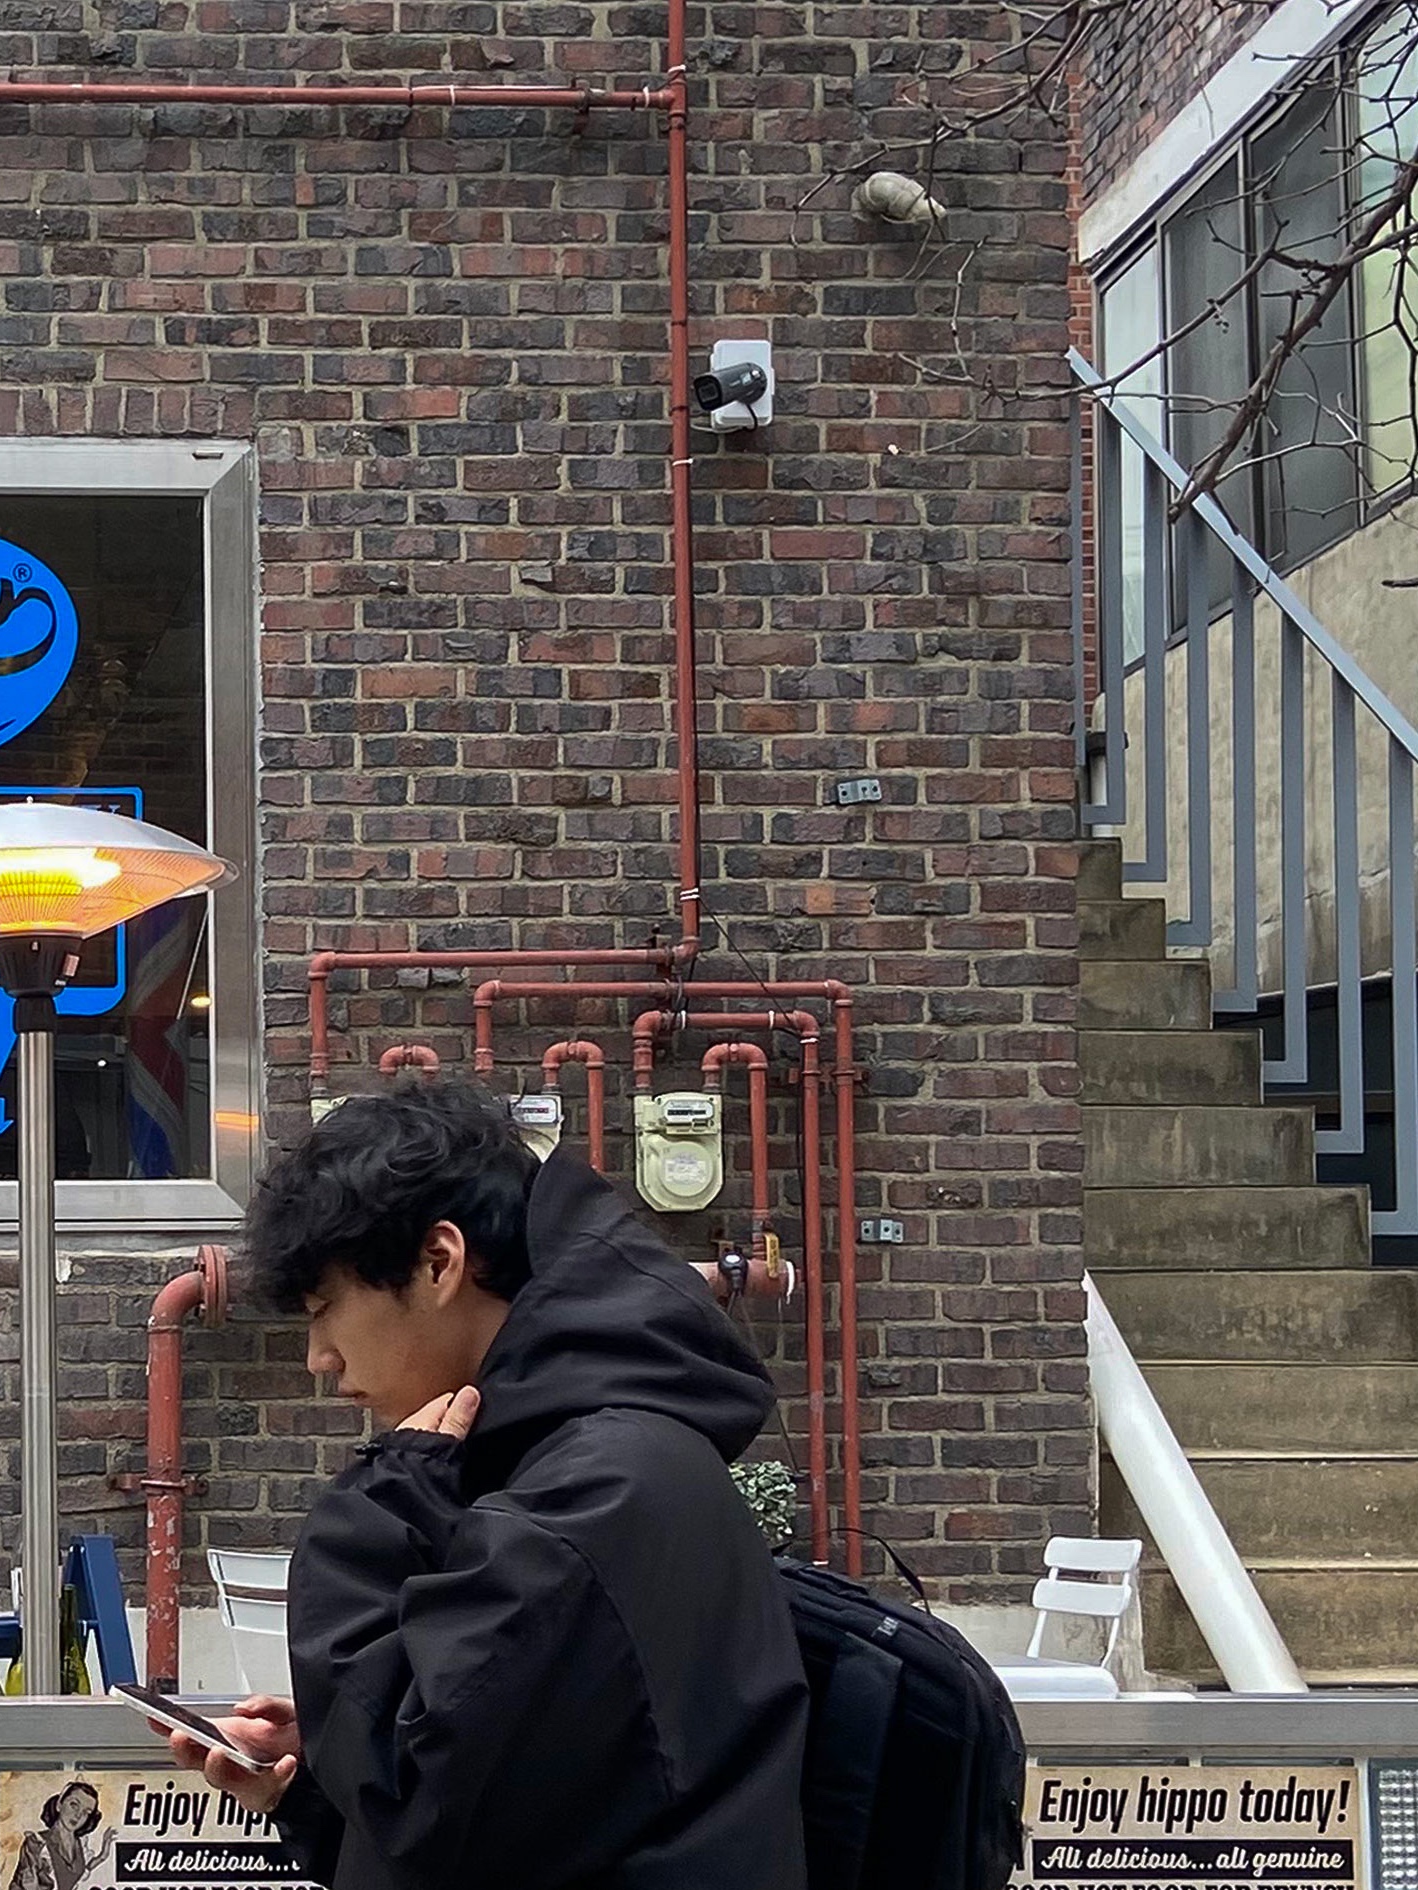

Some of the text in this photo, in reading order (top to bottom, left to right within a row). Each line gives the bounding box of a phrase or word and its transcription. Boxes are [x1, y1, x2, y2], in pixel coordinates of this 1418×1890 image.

[124, 1781, 210, 1836] Enjoy
[1039, 1775, 1350, 1833] Enjoy hippo today!
[124, 1849, 164, 1871] All
[1040, 1846, 1083, 1869] All
[1252, 1847, 1344, 1877] genuine
